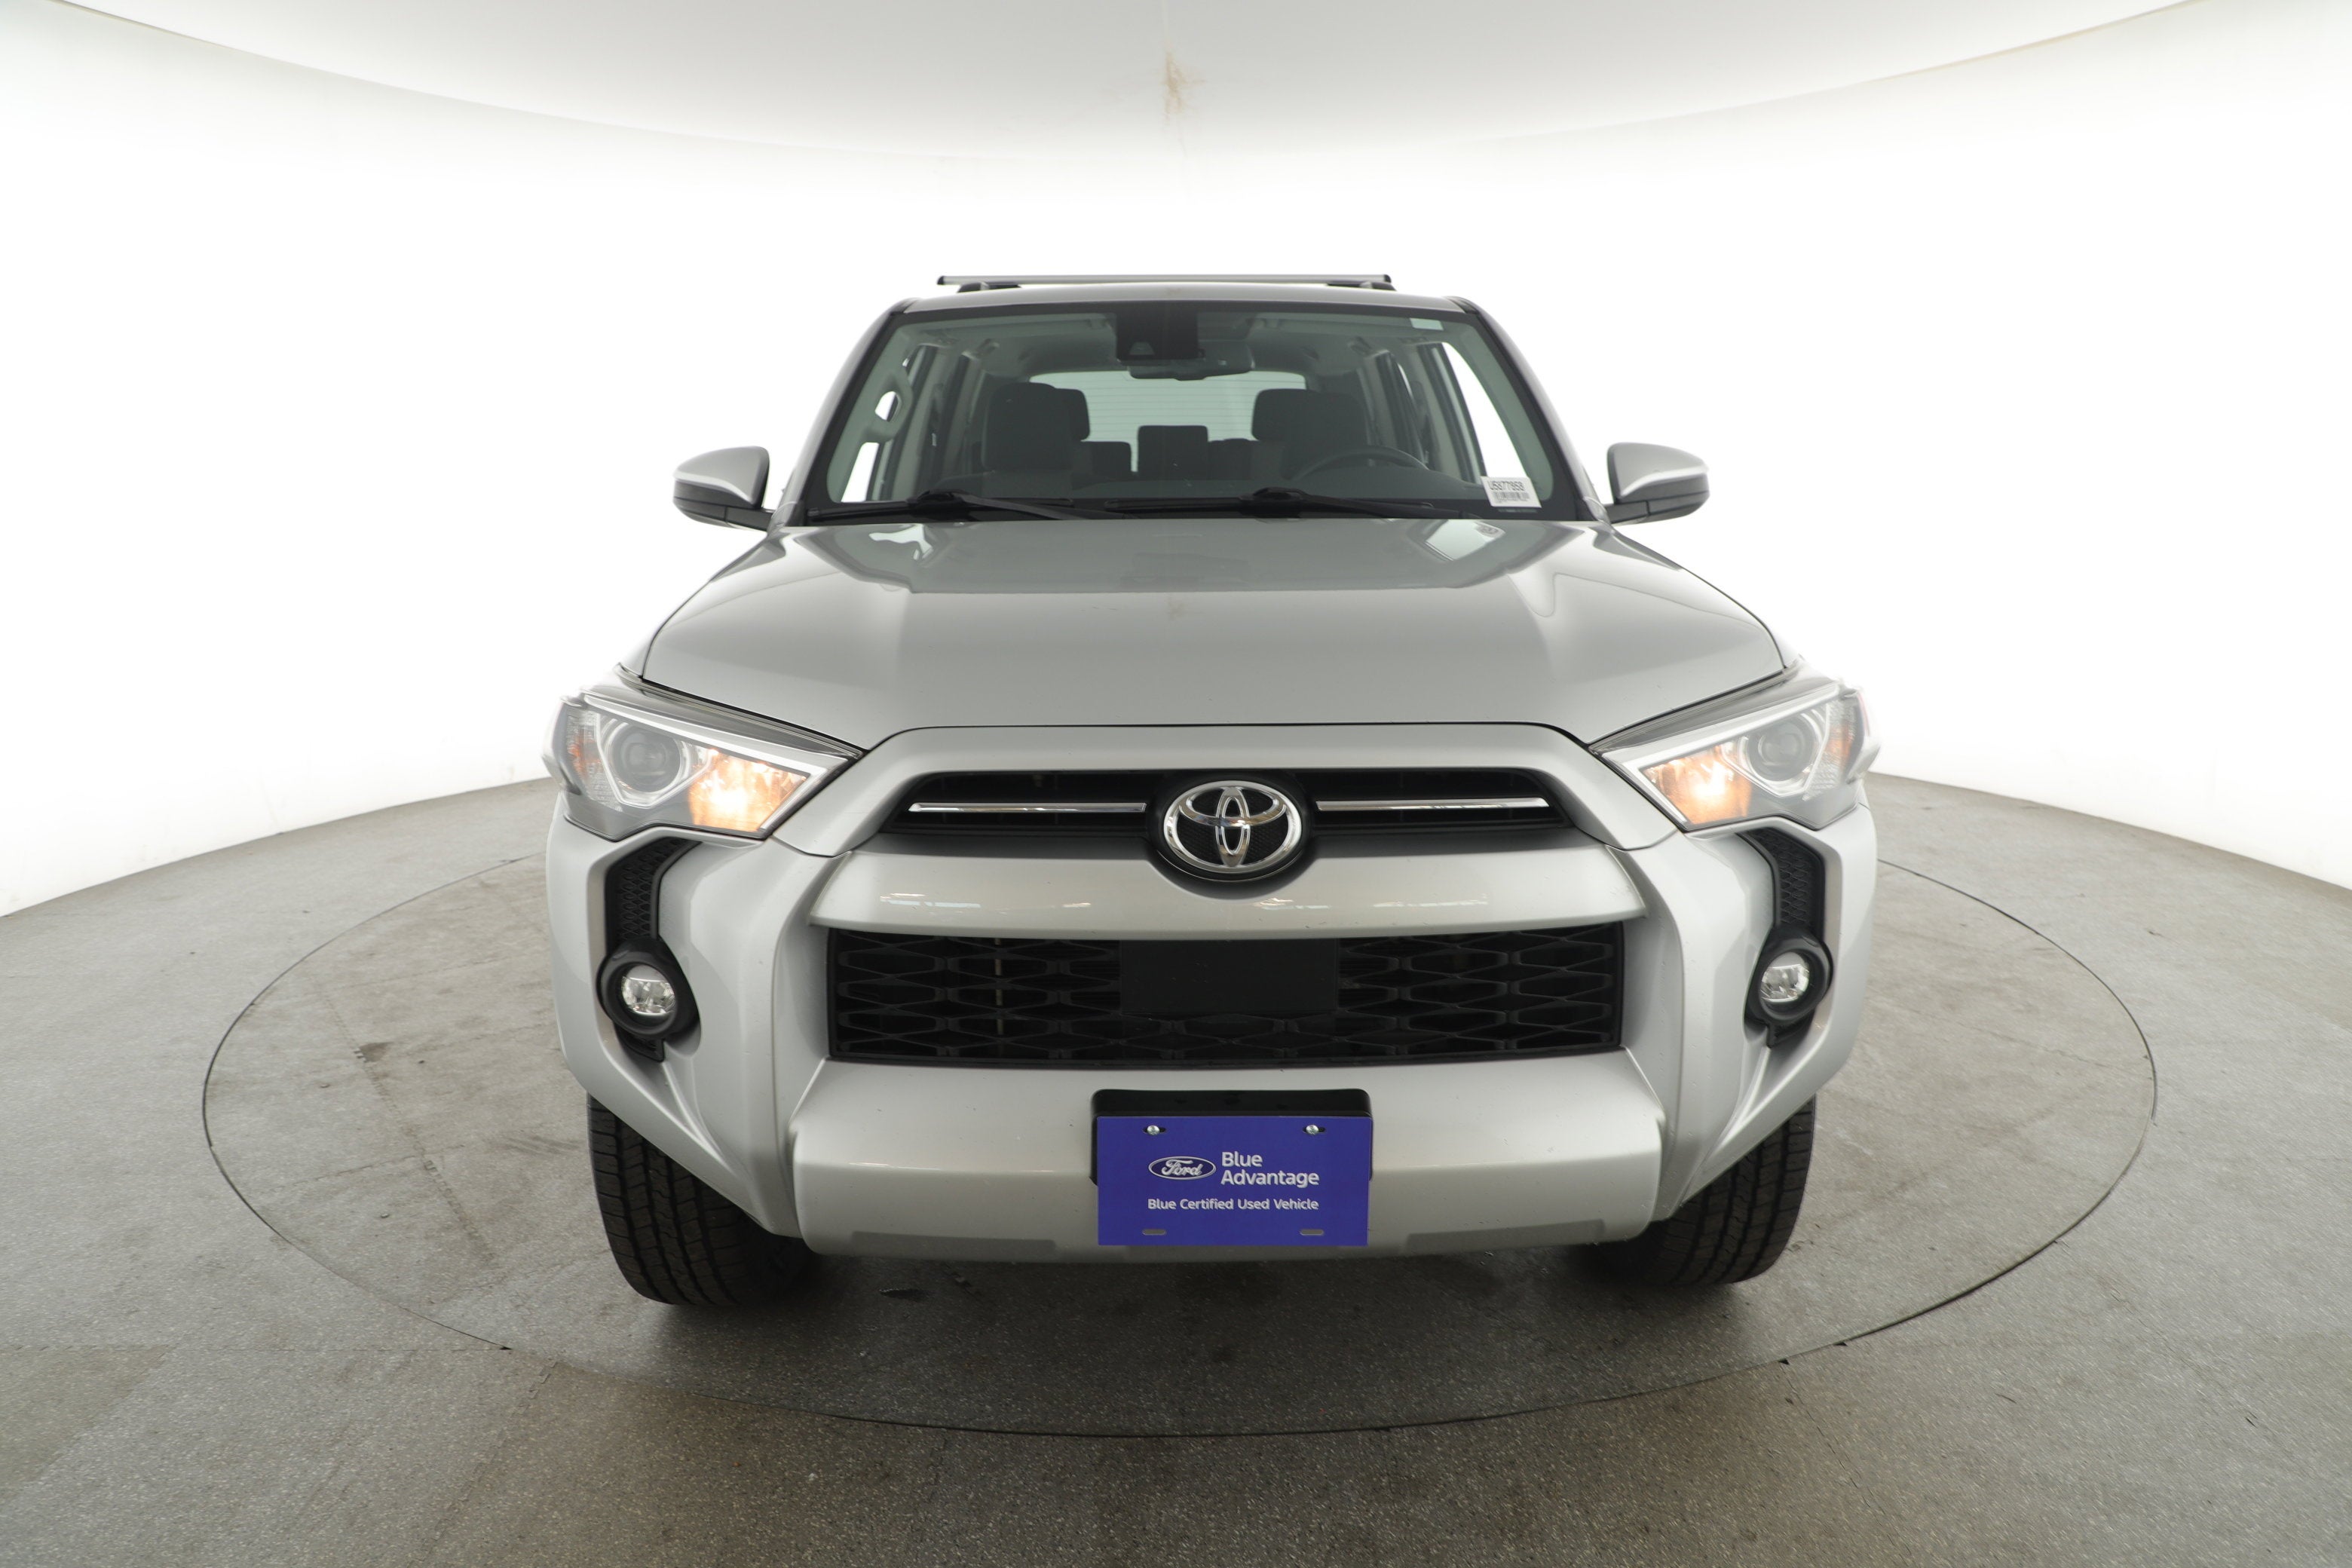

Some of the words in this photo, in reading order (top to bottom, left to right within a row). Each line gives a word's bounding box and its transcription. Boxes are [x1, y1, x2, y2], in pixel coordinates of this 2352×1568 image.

[1161, 1158, 1203, 1177] Ford
[1221, 1150, 1263, 1168] Blue
[1220, 1169, 1320, 1189] Advantage
[1147, 1198, 1177, 1210] Blue
[1179, 1198, 1234, 1210] Certified
[1237, 1198, 1270, 1210] Used
[1273, 1198, 1319, 1210] Vehicle
